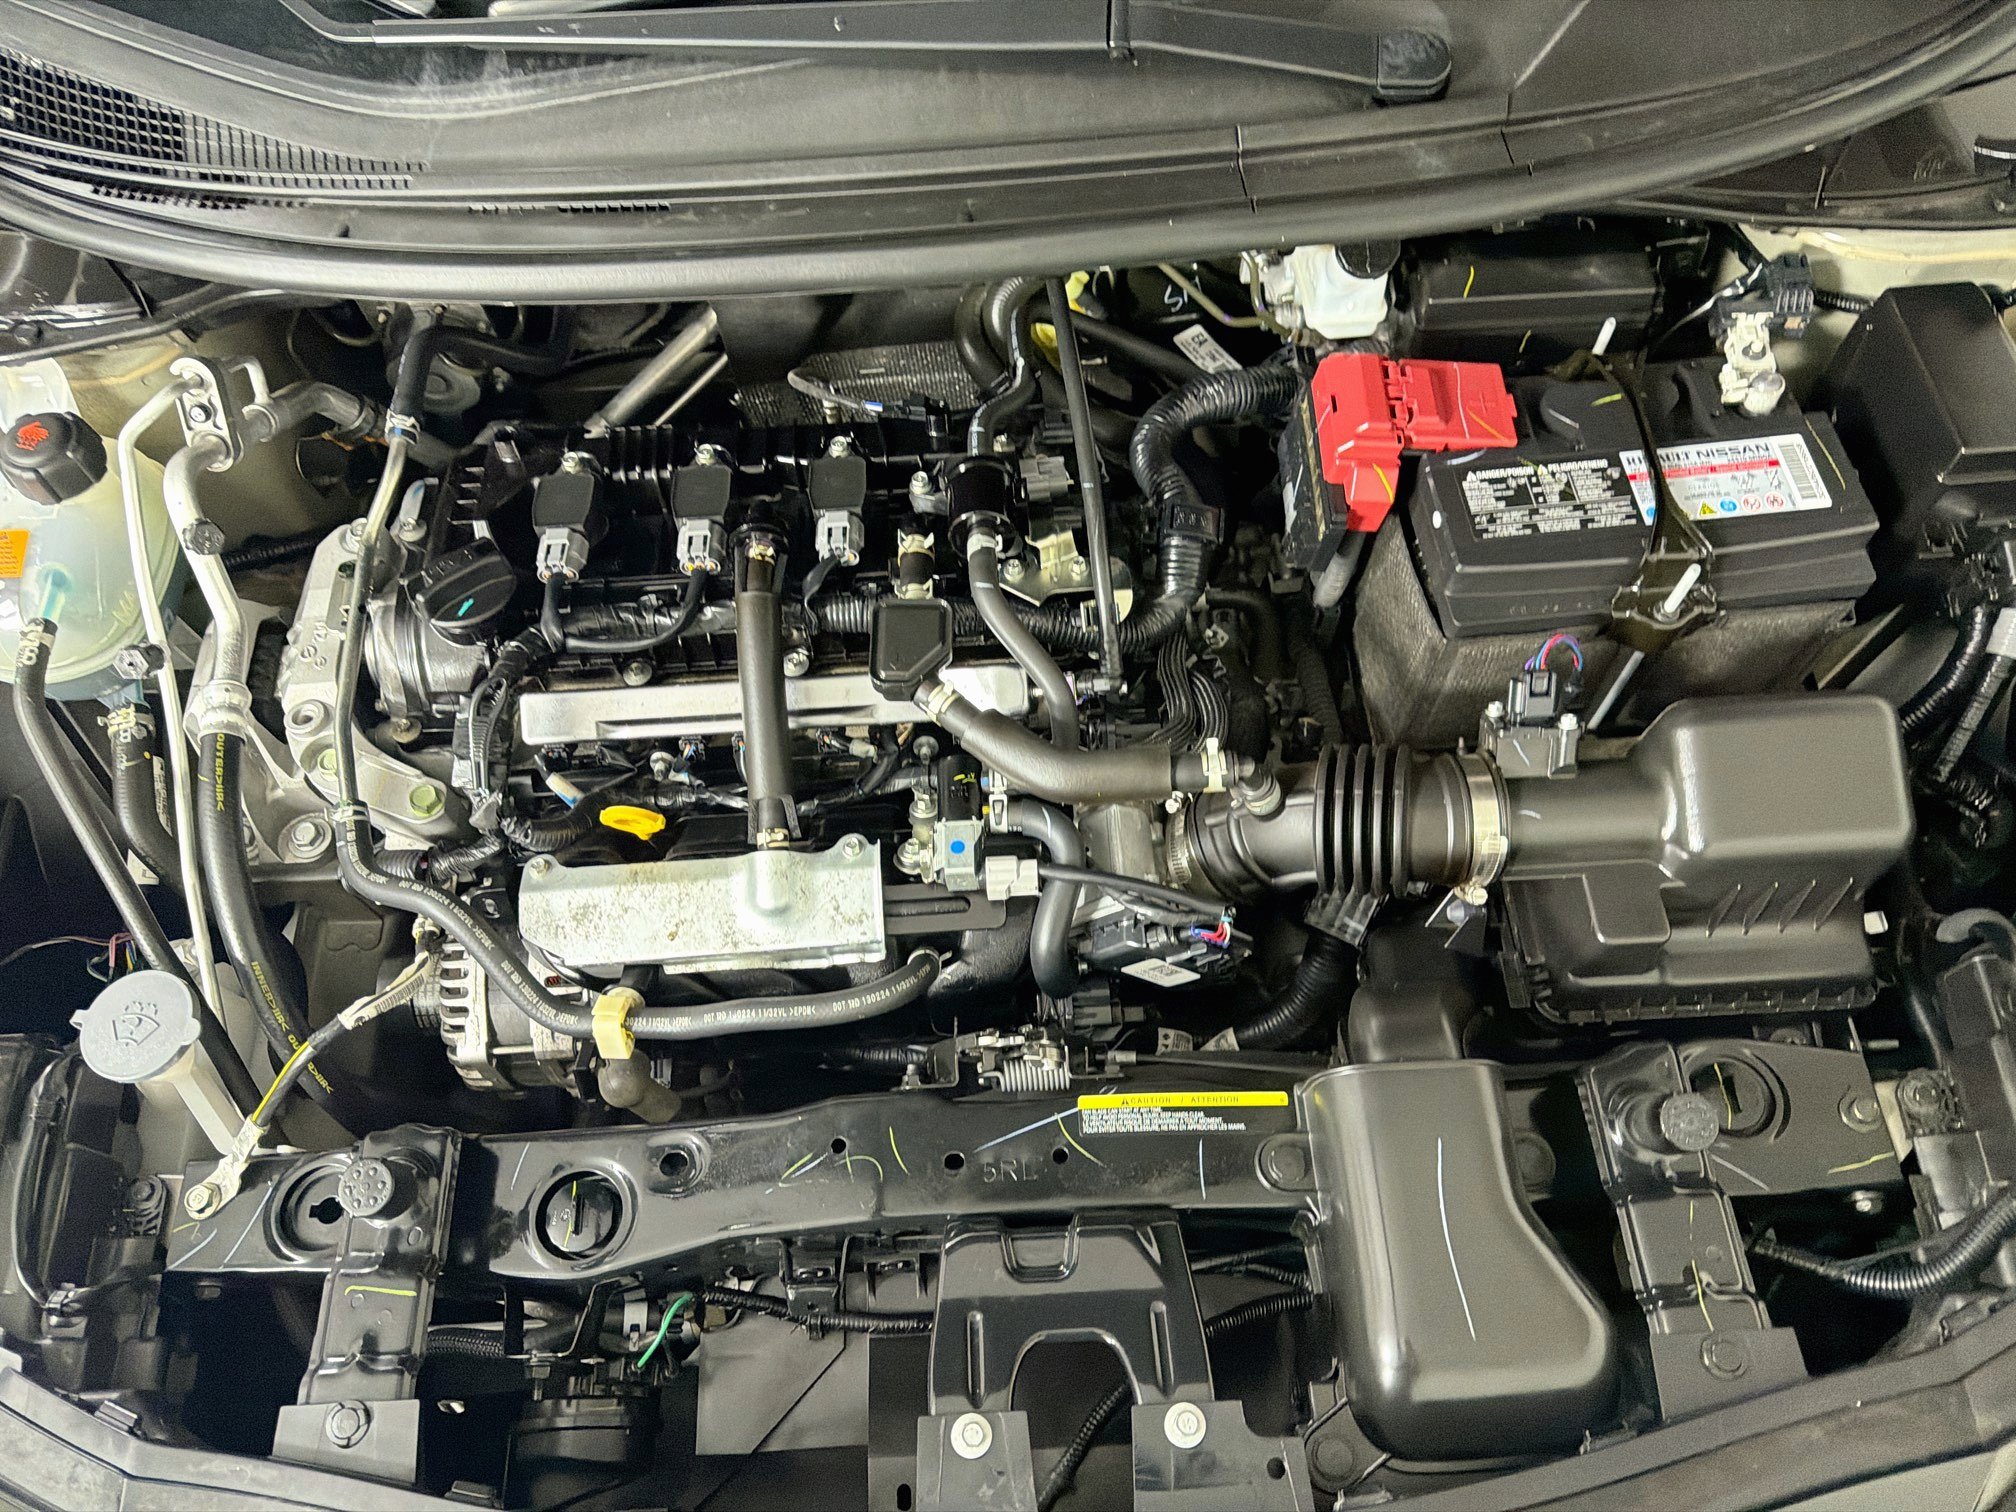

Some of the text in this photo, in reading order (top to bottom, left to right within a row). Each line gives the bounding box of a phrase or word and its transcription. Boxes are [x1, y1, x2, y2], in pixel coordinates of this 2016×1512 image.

[1696, 443, 1770, 458] NISSAN
[1130, 1096, 1171, 1105] CAUTION
[1190, 1095, 1240, 1104] ATTENTION
